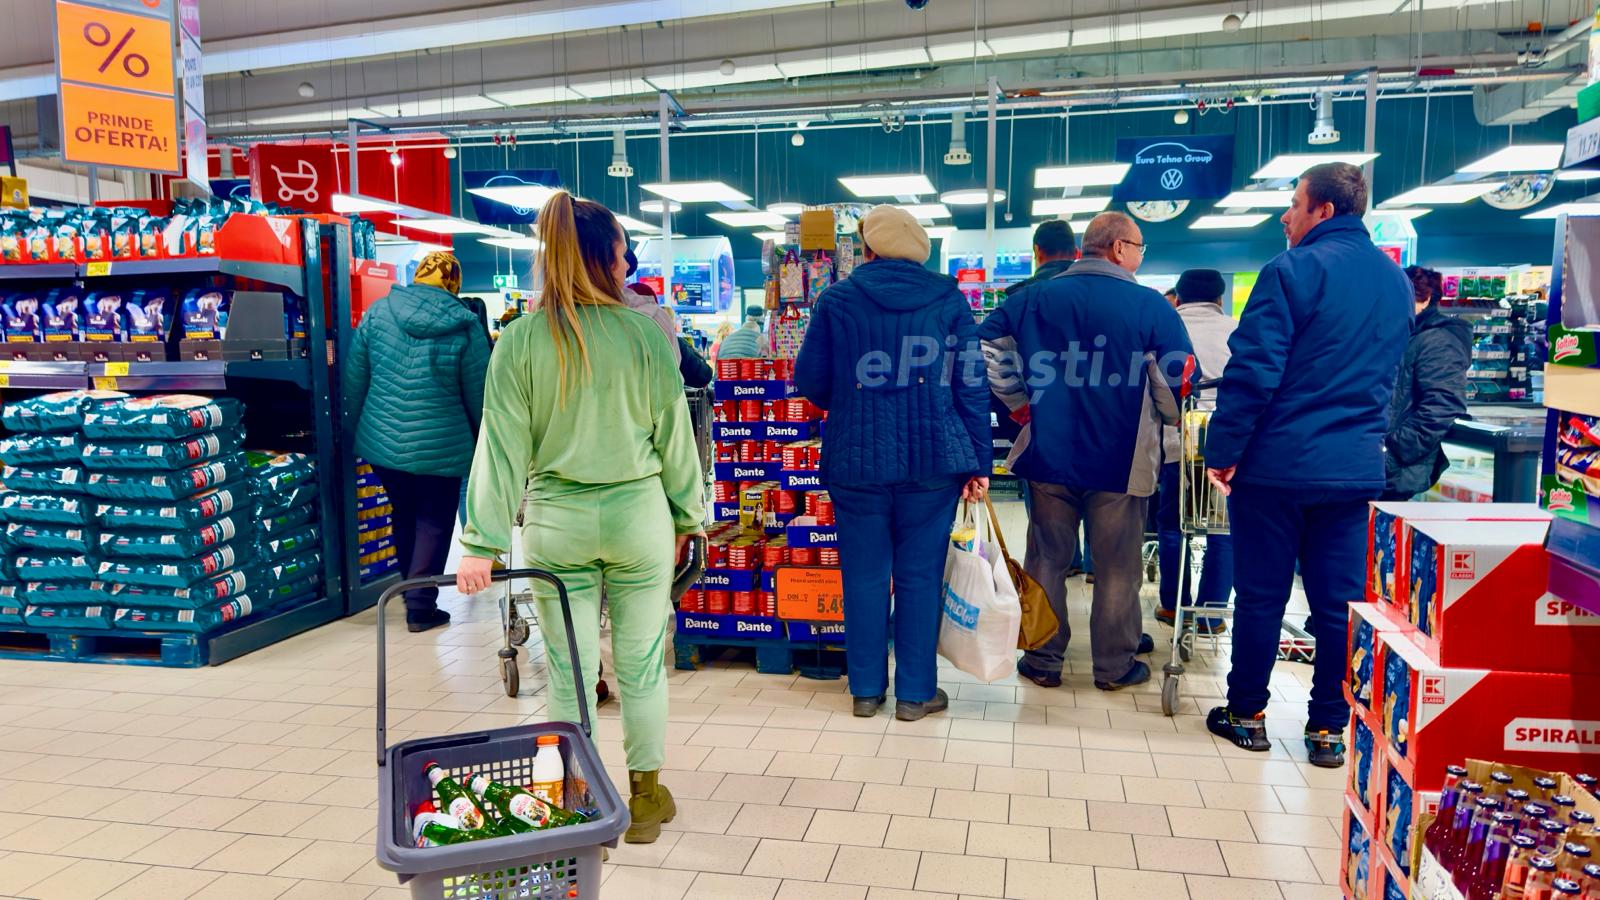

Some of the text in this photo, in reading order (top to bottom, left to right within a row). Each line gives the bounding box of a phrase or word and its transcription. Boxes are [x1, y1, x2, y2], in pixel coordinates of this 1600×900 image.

[83, 22, 150, 78] %
[88, 111, 154, 132] PRINDE
[75, 126, 168, 153] OFERTA!
[1135, 154, 1213, 165] Euro Tehno Group
[734, 386, 765, 396] Dante
[721, 427, 751, 437] Dante
[767, 426, 799, 437] Dante
[734, 467, 765, 478] Dante
[685, 618, 720, 630] Dante
[737, 621, 773, 632] Dante
